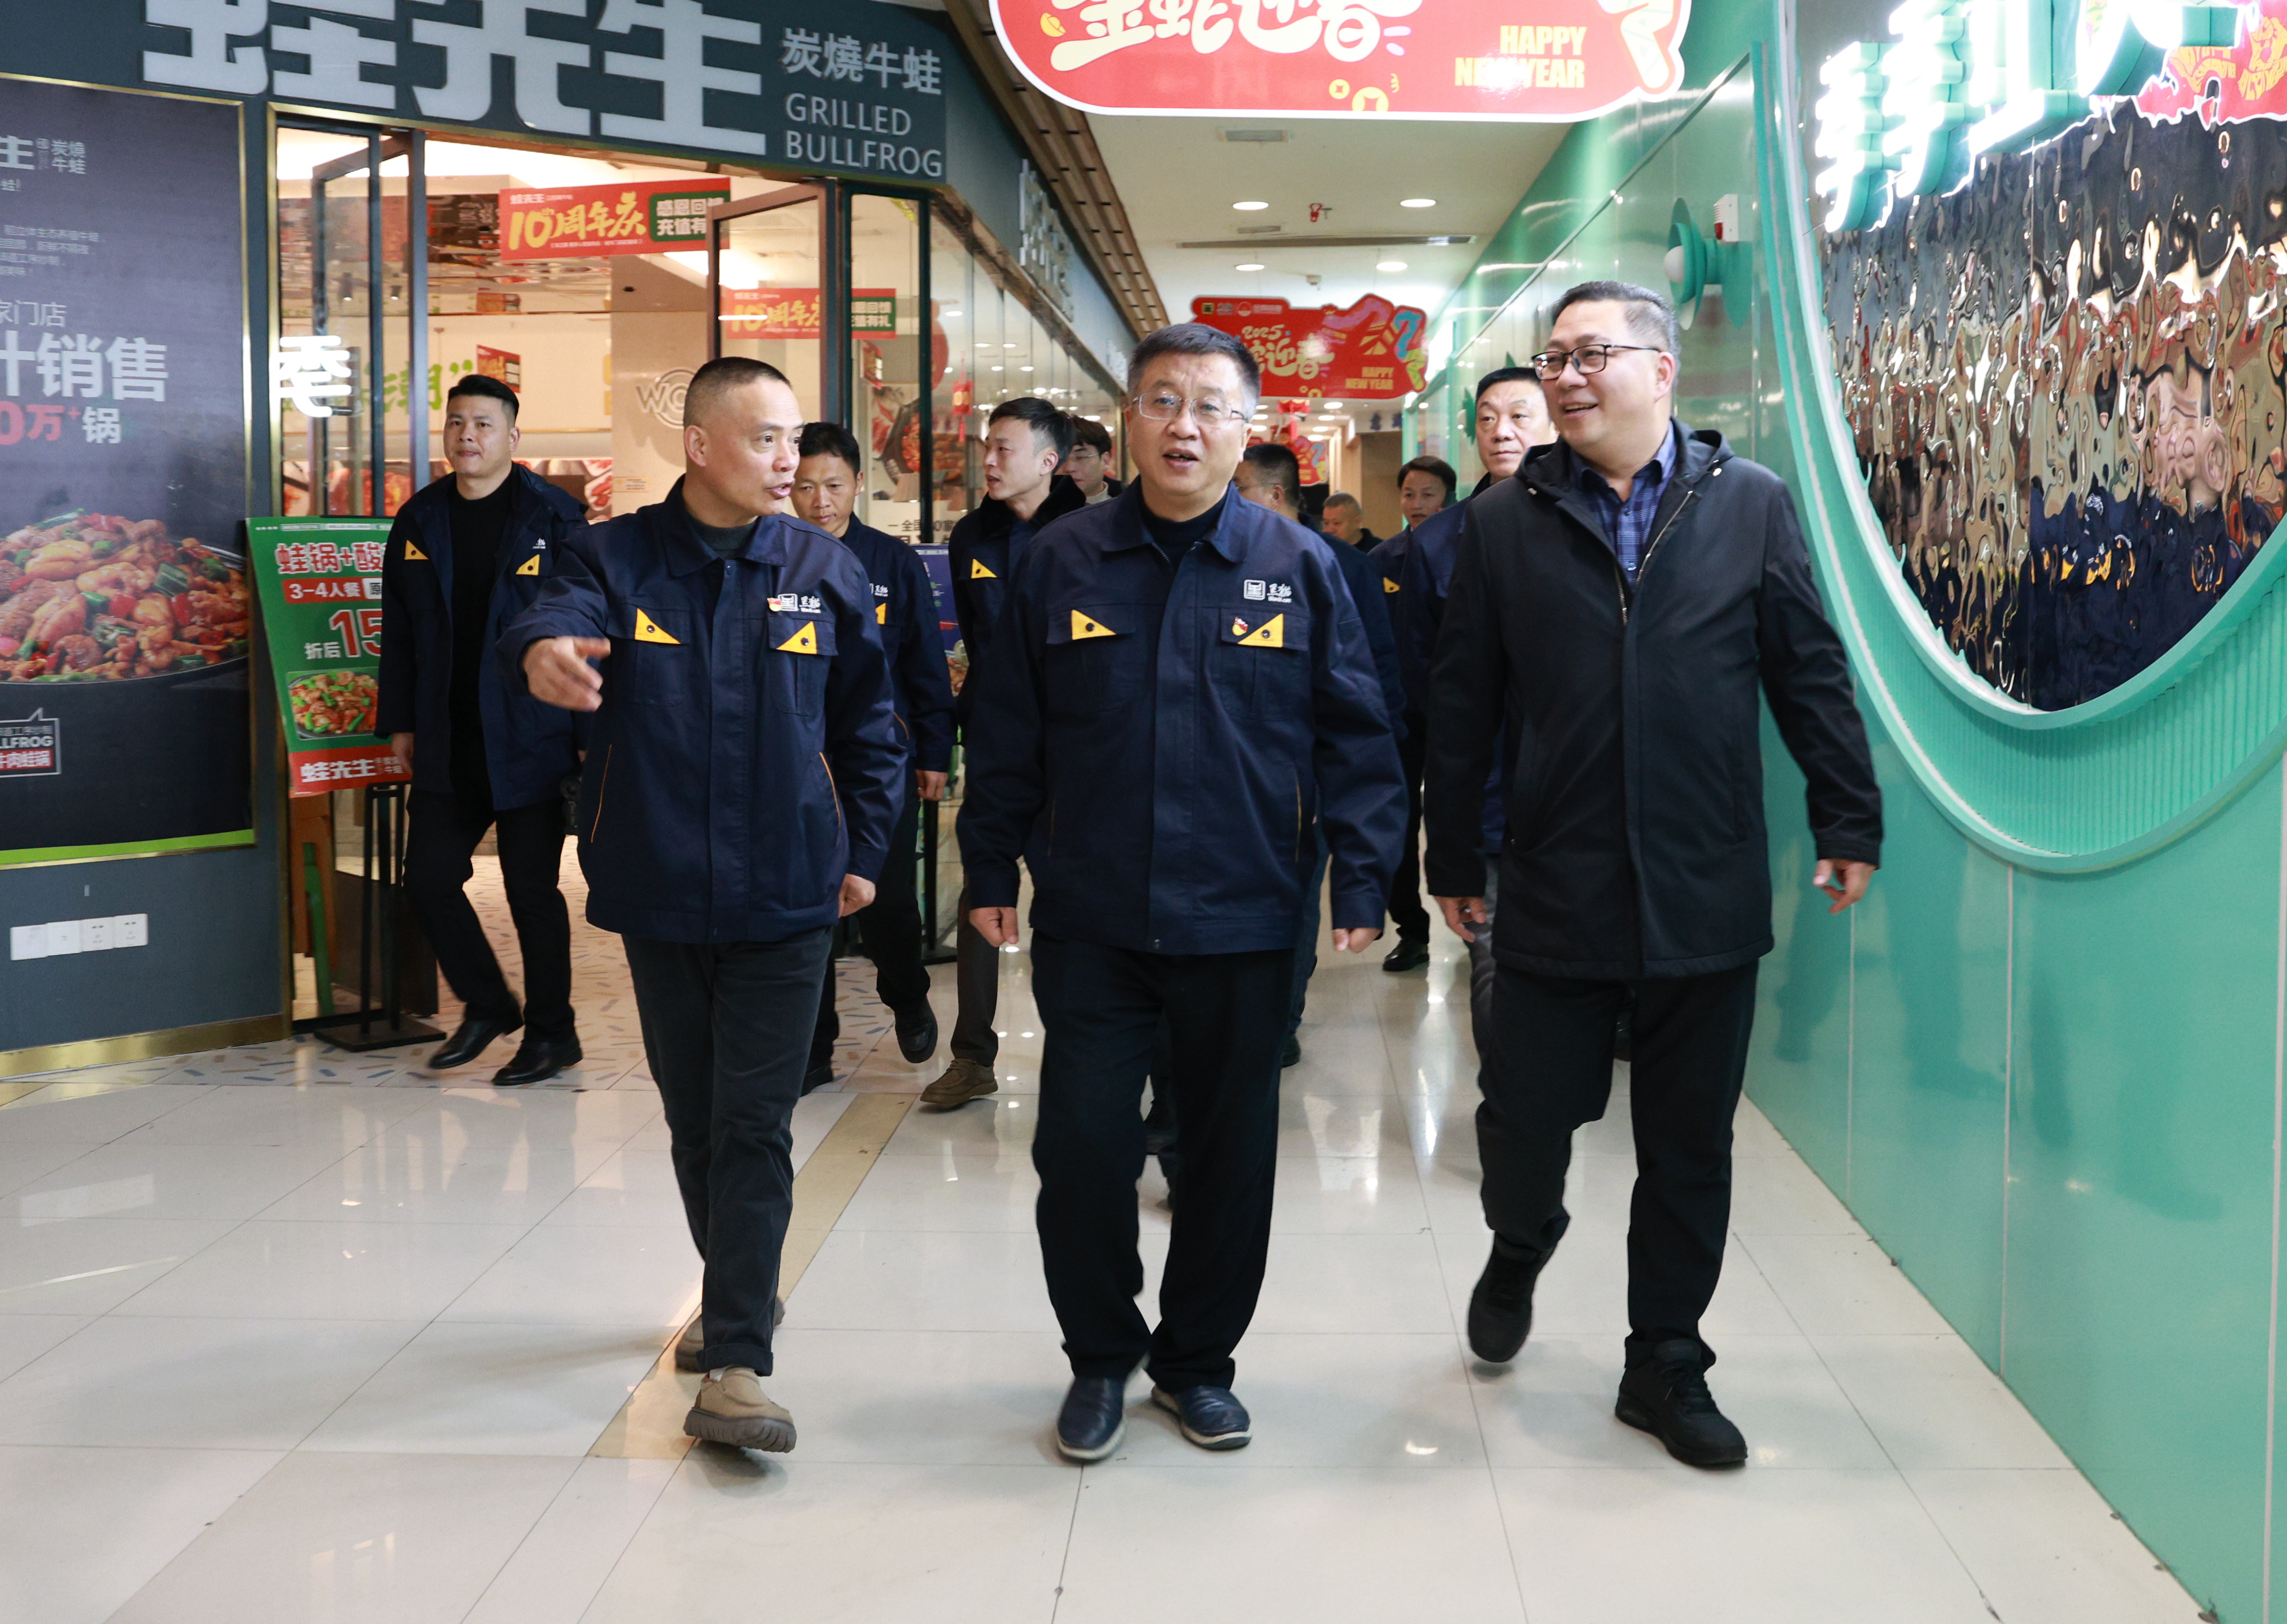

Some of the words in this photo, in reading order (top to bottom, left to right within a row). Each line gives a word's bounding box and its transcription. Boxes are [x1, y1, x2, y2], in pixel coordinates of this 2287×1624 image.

[1500, 25, 1587, 56] HAPPY
[1518, 58, 1585, 88] YEAR
[785, 93, 912, 136] GRILLED
[786, 130, 942, 177] BULLFROG
[1242, 324, 1285, 340] 2025
[1345, 378, 1368, 389] NEW
[1370, 379, 1394, 390] YEAR
[274, 542, 387, 574] 蛙锅+酸
[304, 641, 341, 660] 折后
[0, 735, 54, 749] LFROG
[300, 759, 377, 783] 蛙先生
